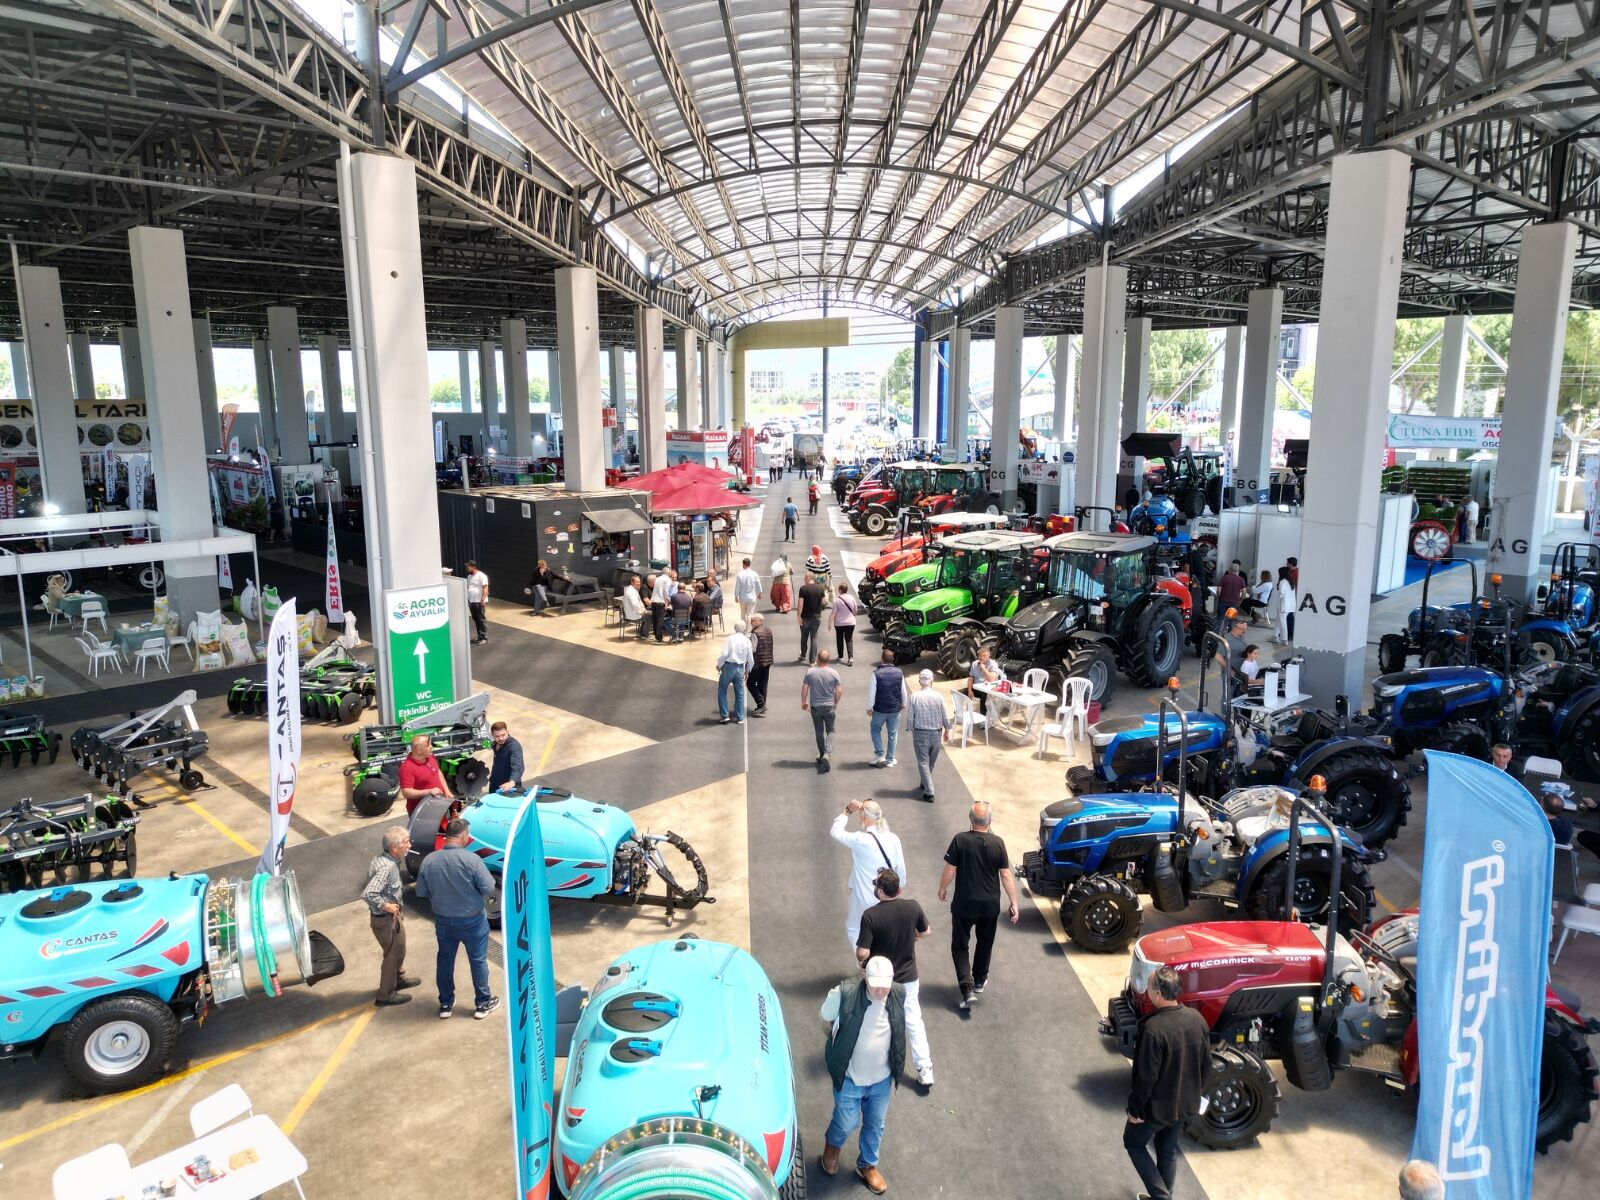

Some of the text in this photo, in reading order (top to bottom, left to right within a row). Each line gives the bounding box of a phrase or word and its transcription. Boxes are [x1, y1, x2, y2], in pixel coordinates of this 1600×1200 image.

[92, 404, 147, 418] TARI
[1402, 427, 1441, 437] TUNA
[410, 597, 446, 610] AGRO
[410, 607, 446, 619] AYVALIK
[276, 634, 287, 760] ANTAŞ
[416, 690, 432, 700] WC
[398, 705, 429, 718] Etkinlik
